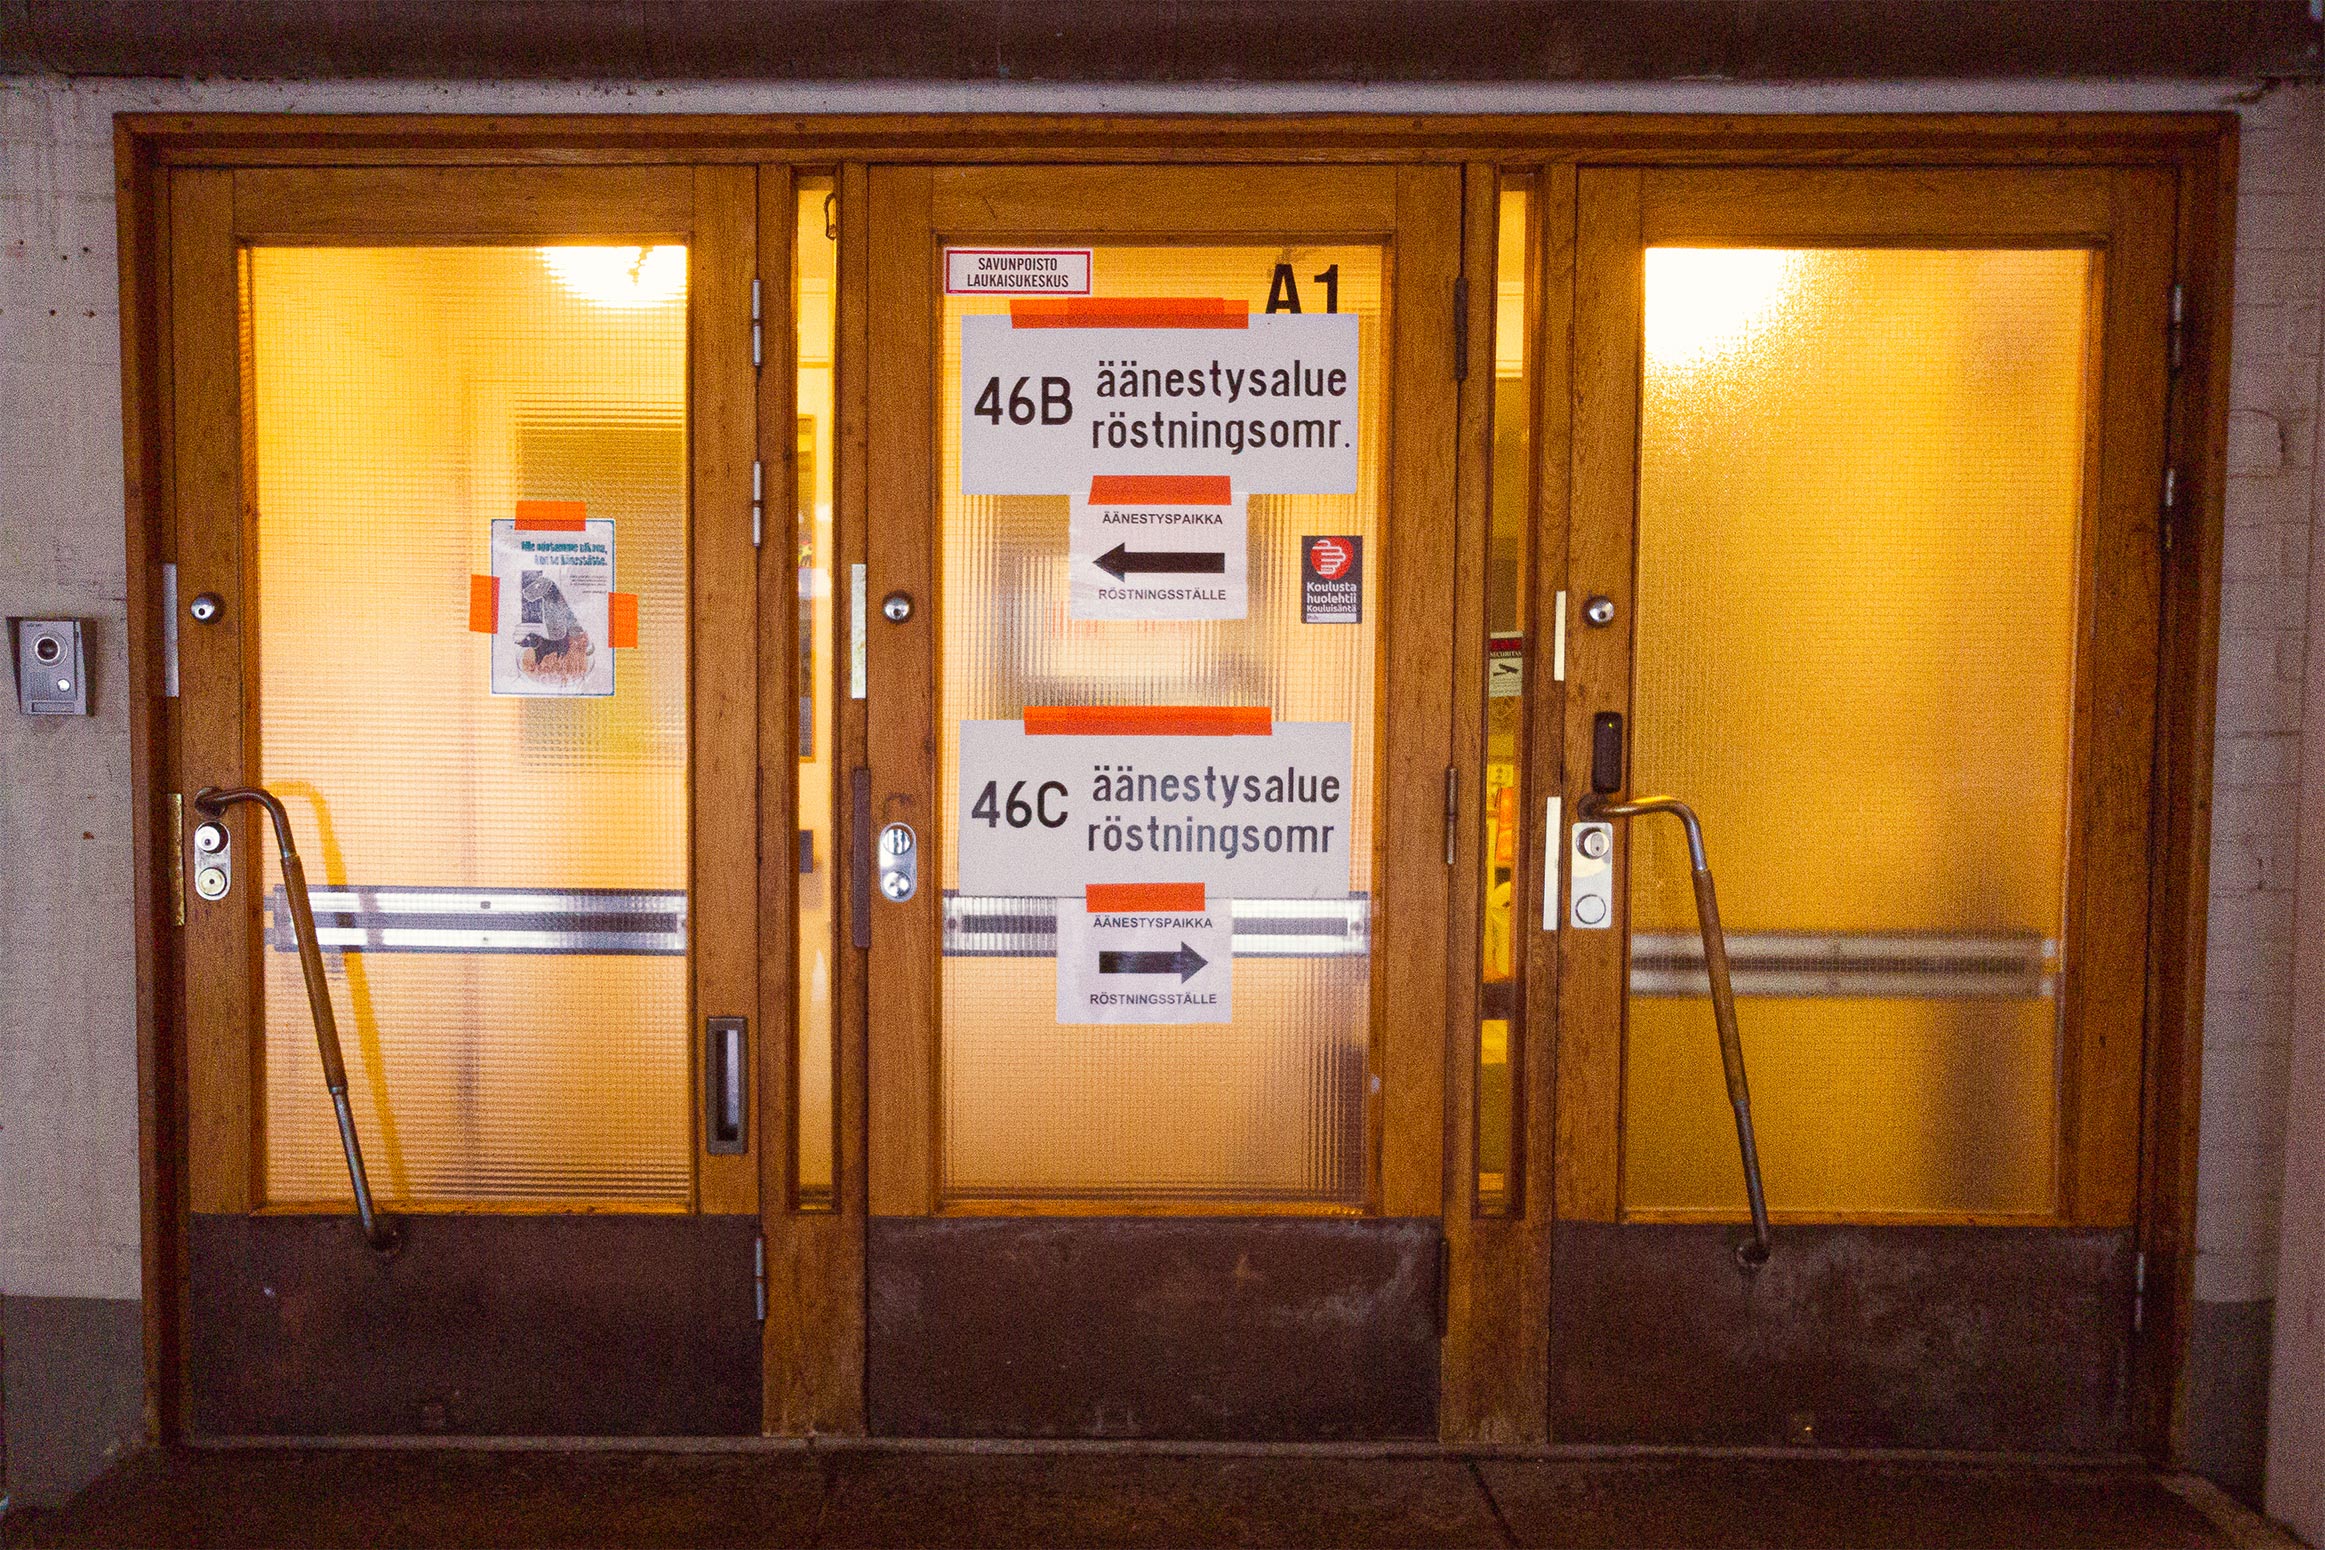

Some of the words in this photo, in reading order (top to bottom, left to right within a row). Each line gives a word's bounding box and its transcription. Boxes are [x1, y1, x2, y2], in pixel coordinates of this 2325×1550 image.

[978, 257, 1058, 271] SAVUNPOISTO
[967, 273, 1069, 288] LAUKAISUKESKUS
[1096, 359, 1347, 404] äänestysalue
[974, 376, 1073, 426] 46B
[1092, 411, 1350, 456] röstningsomr.
[1102, 511, 1223, 525] ÄÄNESTYSPAIKKA
[1306, 581, 1357, 592] Koulusta
[1098, 588, 1226, 601] RÖSTNINGSSTÄLLE
[1306, 592, 1357, 604] huolehtii
[1306, 603, 1357, 613] Kouluisäntä
[1092, 764, 1340, 809] äänestysalue
[971, 780, 1069, 829] 46C
[1088, 815, 1335, 860] röstningsomr
[1093, 915, 1213, 929] ÄÄNESTYSPAIKKA
[1089, 991, 1217, 1005] RÖSTNINGSSTÄLLE
